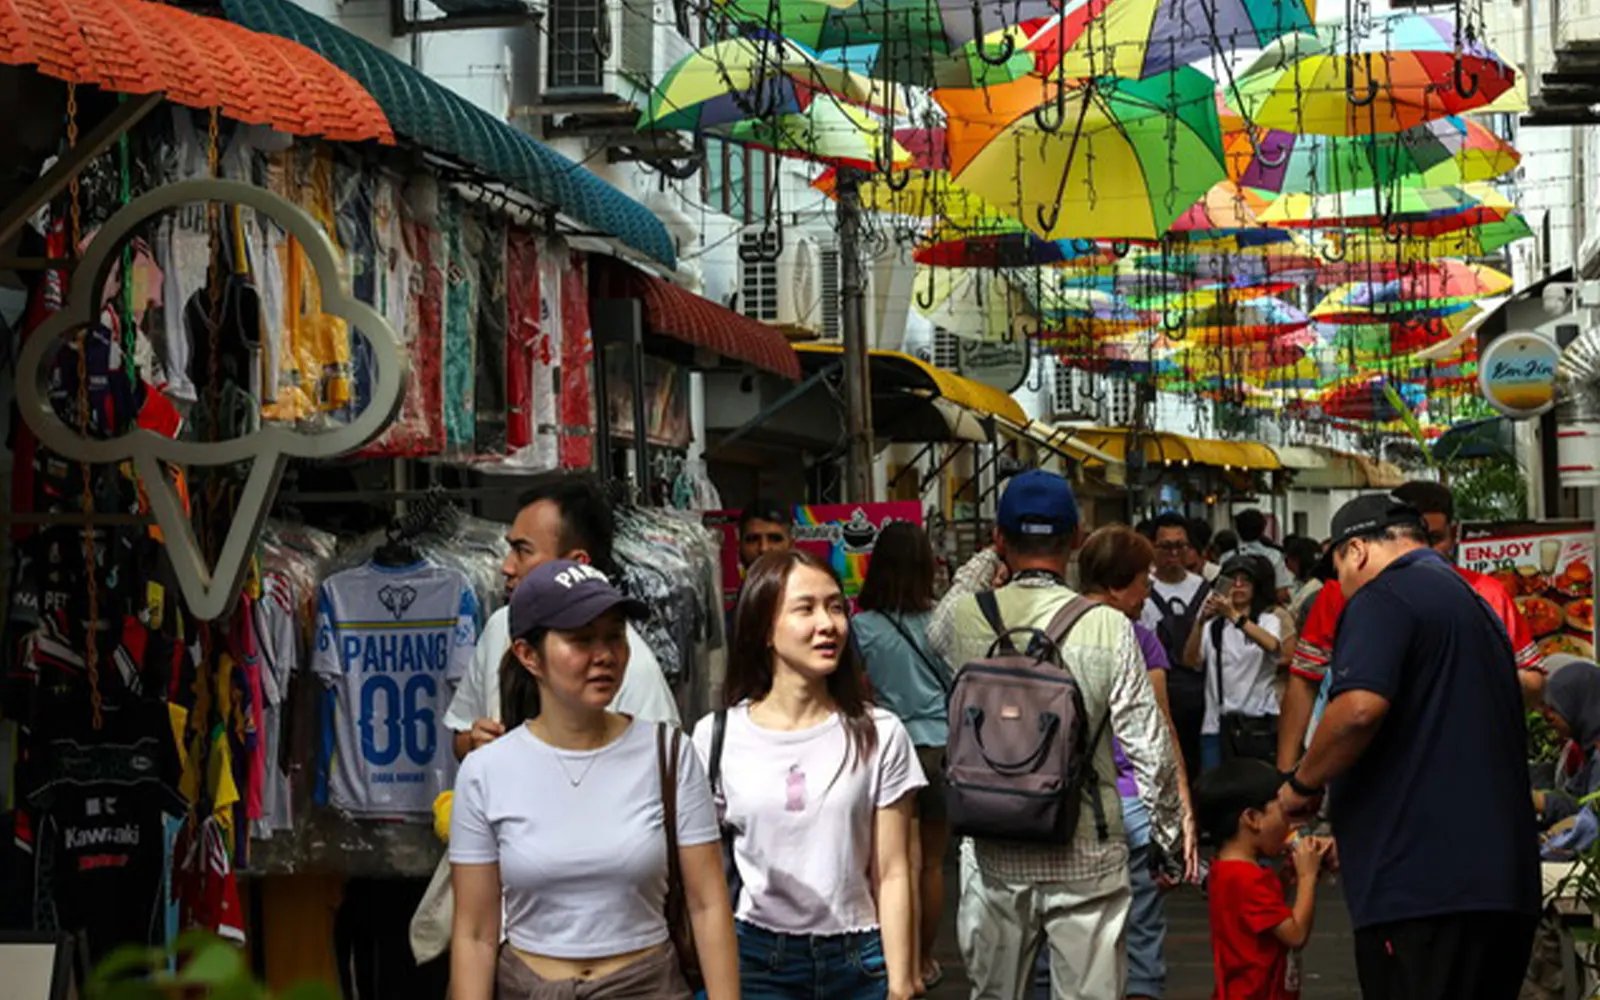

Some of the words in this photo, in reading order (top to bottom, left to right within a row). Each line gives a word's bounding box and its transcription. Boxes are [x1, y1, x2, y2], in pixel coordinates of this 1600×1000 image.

[1465, 542, 1534, 561] ENJOY
[343, 632, 448, 674] PAHANG
[357, 673, 438, 767] 06
